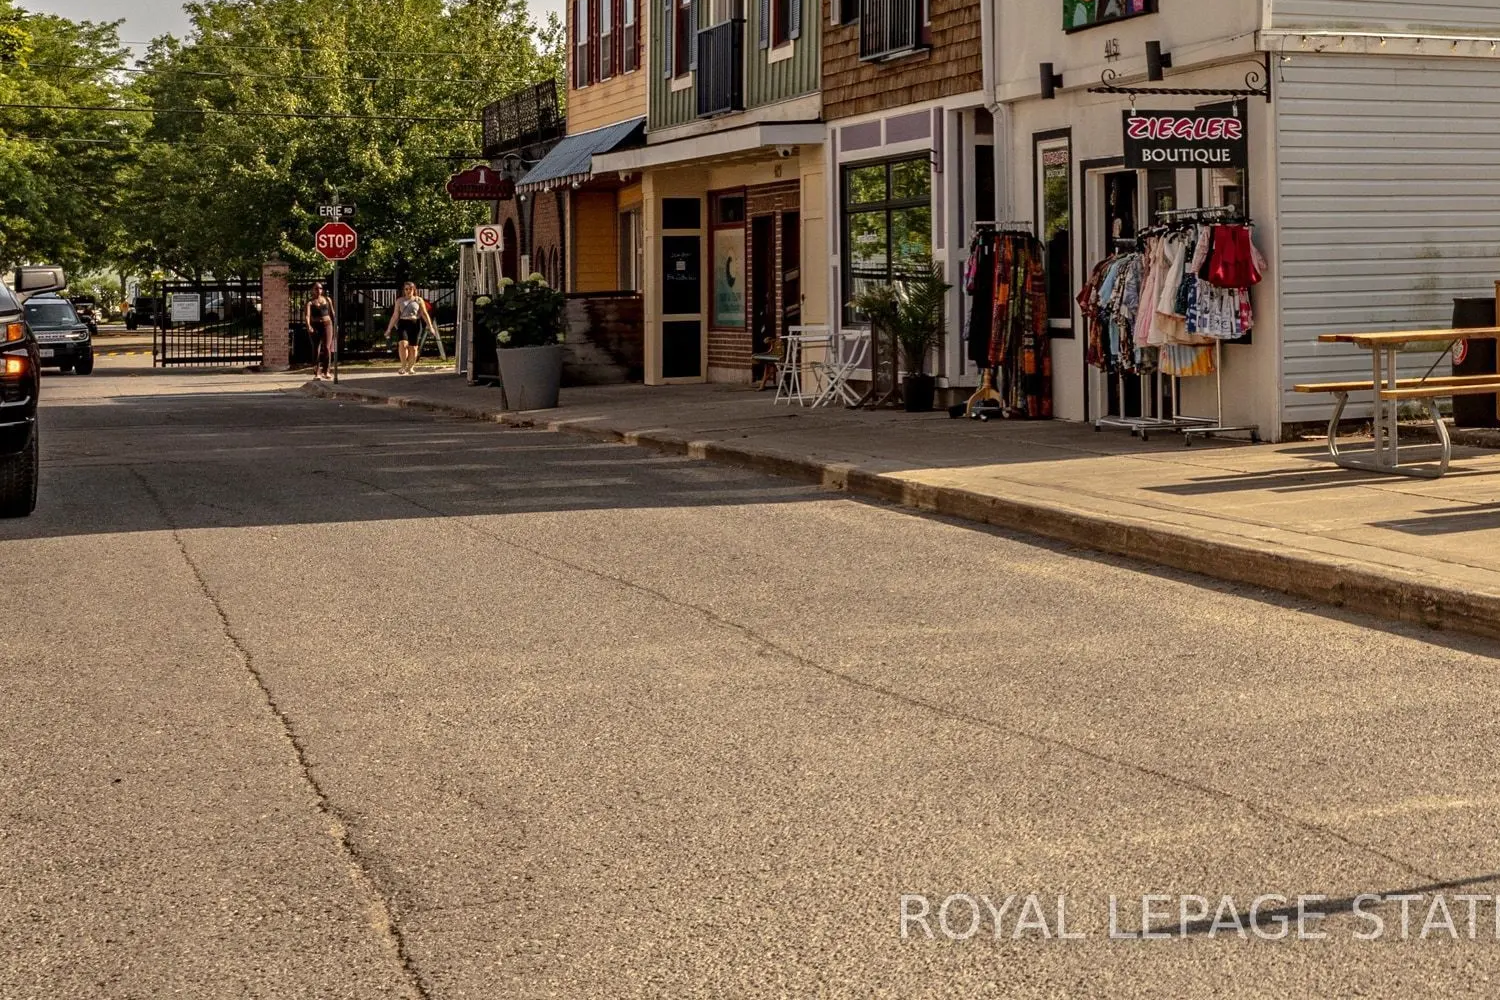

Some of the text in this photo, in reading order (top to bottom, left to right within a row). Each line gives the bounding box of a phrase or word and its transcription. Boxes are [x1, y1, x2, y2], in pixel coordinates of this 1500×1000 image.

[1127, 117, 1242, 141] ZIEGLER
[1142, 148, 1231, 163] BOUTIQUE
[319, 205, 343, 217] ERIE
[318, 234, 354, 248] STOP
